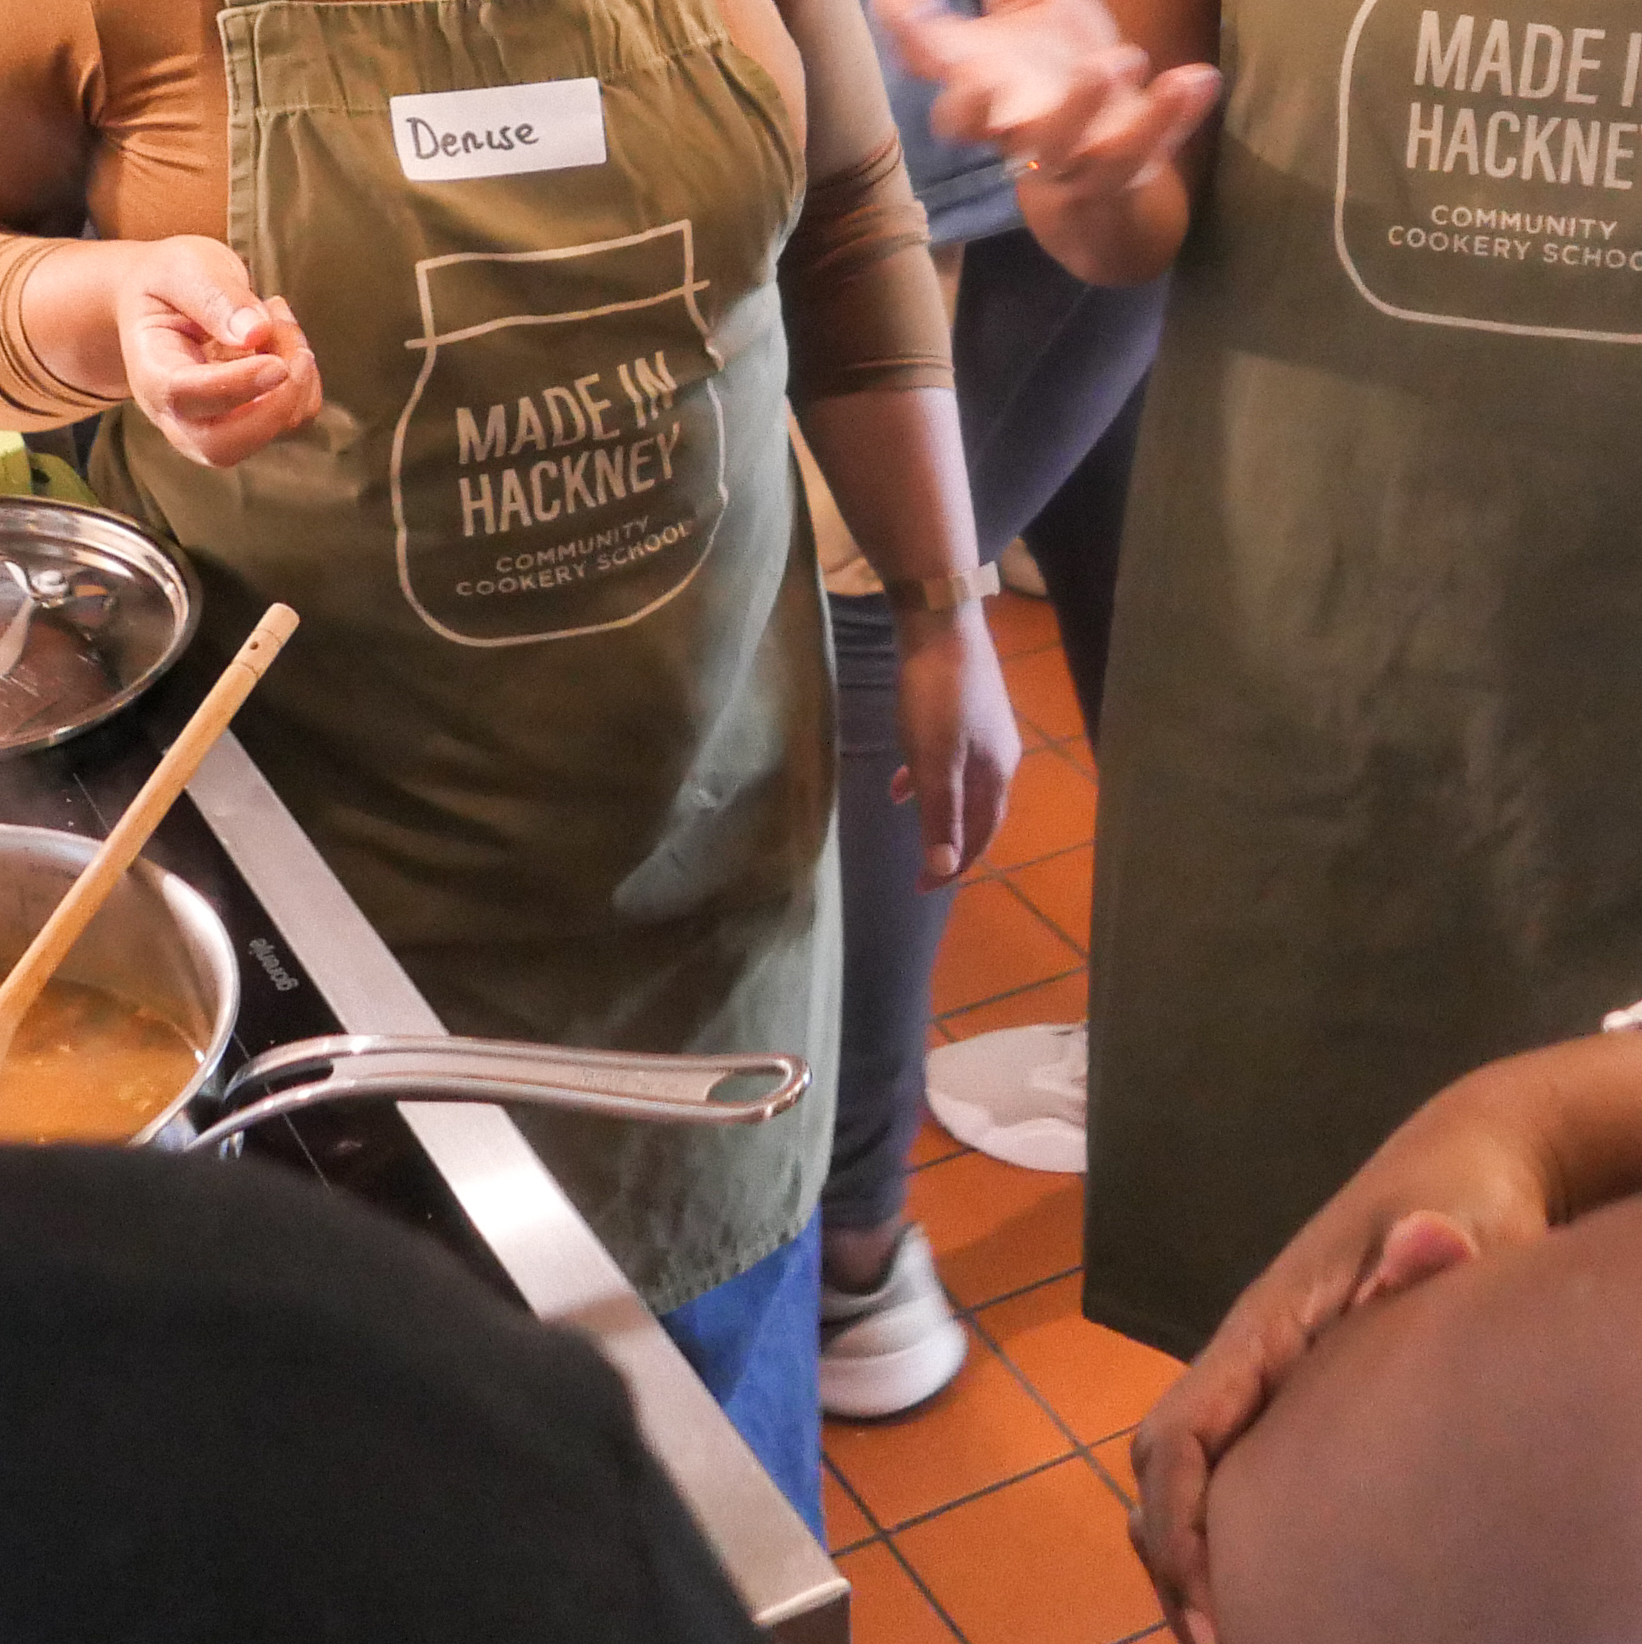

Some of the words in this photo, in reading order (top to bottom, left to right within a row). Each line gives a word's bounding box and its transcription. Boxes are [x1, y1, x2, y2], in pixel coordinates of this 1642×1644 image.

[1413, 9, 1606, 104] MADE
[406, 117, 539, 159] Denise
[1388, 225, 1531, 261] COOKERY
[1430, 204, 1618, 240] COMMUNITY
[456, 372, 620, 465] MADE
[617, 350, 677, 429] IN
[459, 421, 680, 537] HACKNEY
[456, 561, 587, 596] COOKERY
[597, 521, 690, 570] SCHOOL
[496, 515, 649, 573] COMMUNITY
